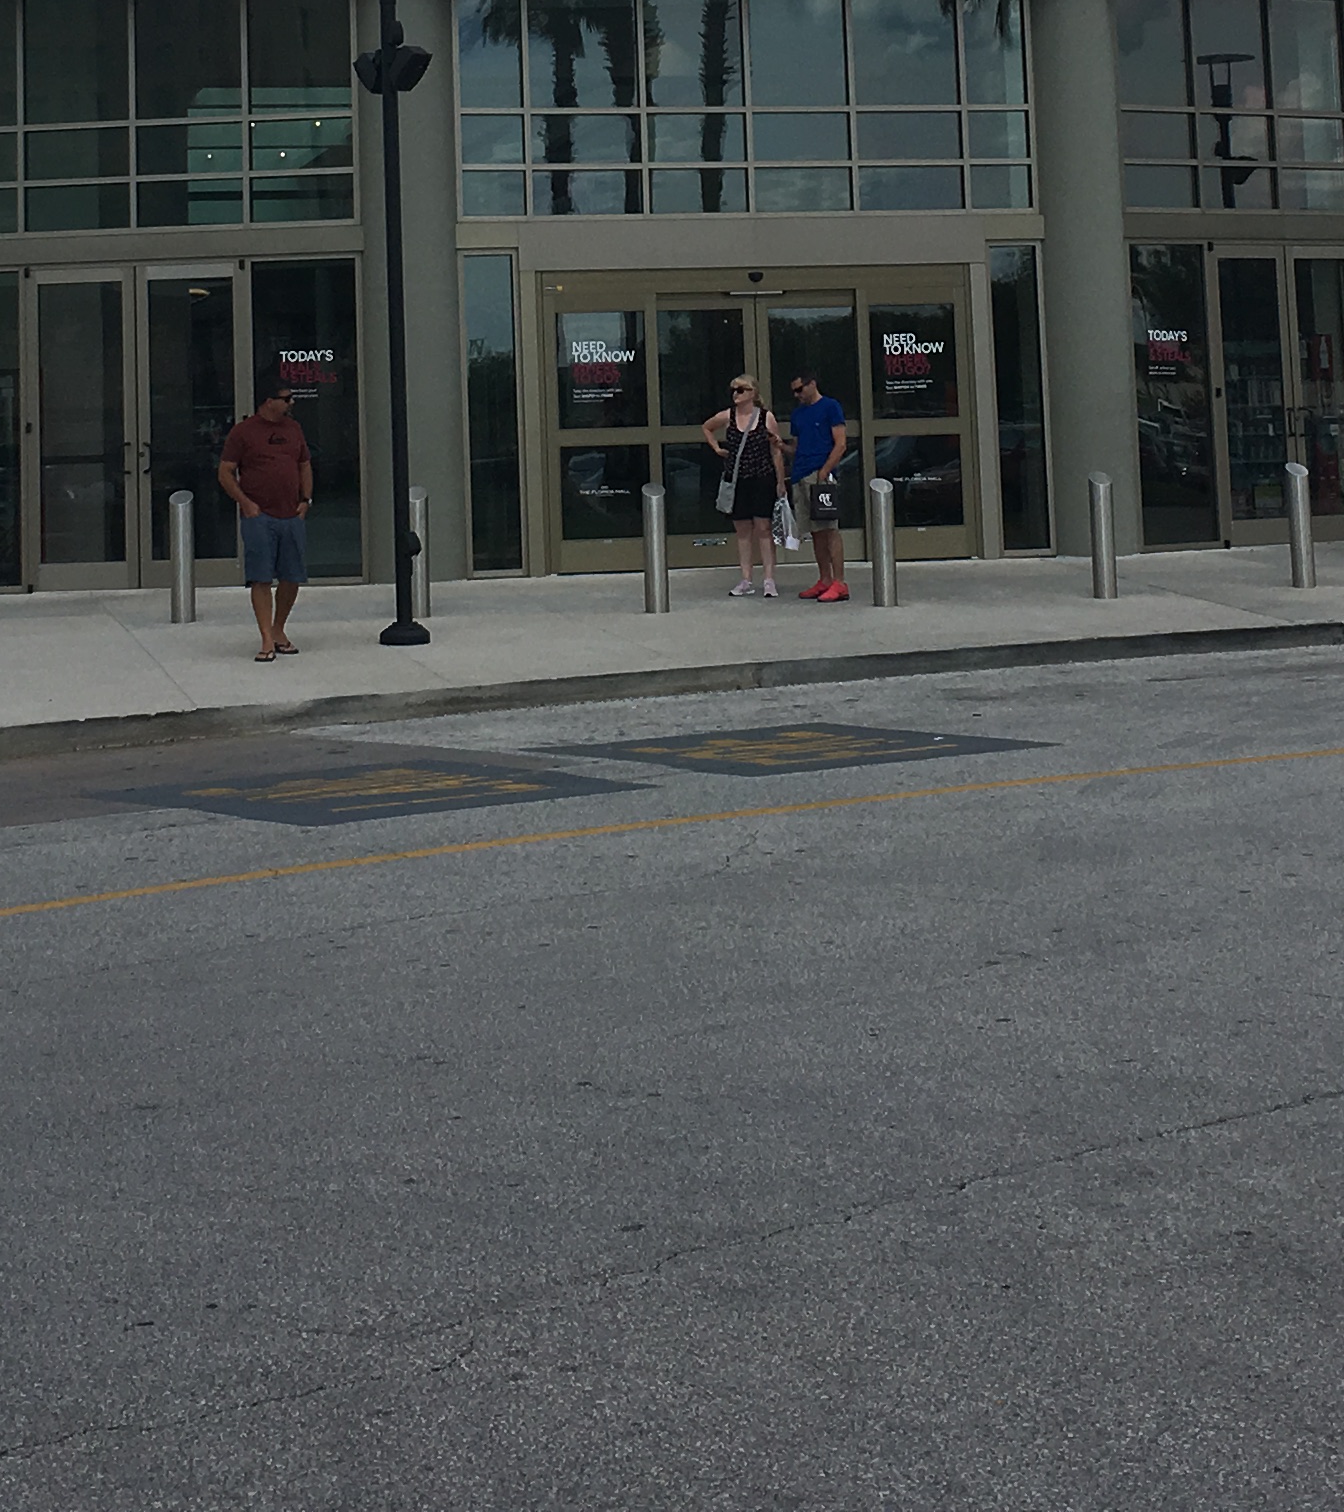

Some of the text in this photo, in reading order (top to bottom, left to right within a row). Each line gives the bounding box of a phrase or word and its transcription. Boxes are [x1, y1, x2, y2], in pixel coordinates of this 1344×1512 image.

[883, 333, 916, 346] NEED
[1147, 329, 1188, 342] TODAY'S
[572, 341, 606, 353] NEED
[883, 341, 944, 355] TO KNOW
[279, 349, 334, 363] TODAY'S
[572, 350, 635, 363] TO KNOW
